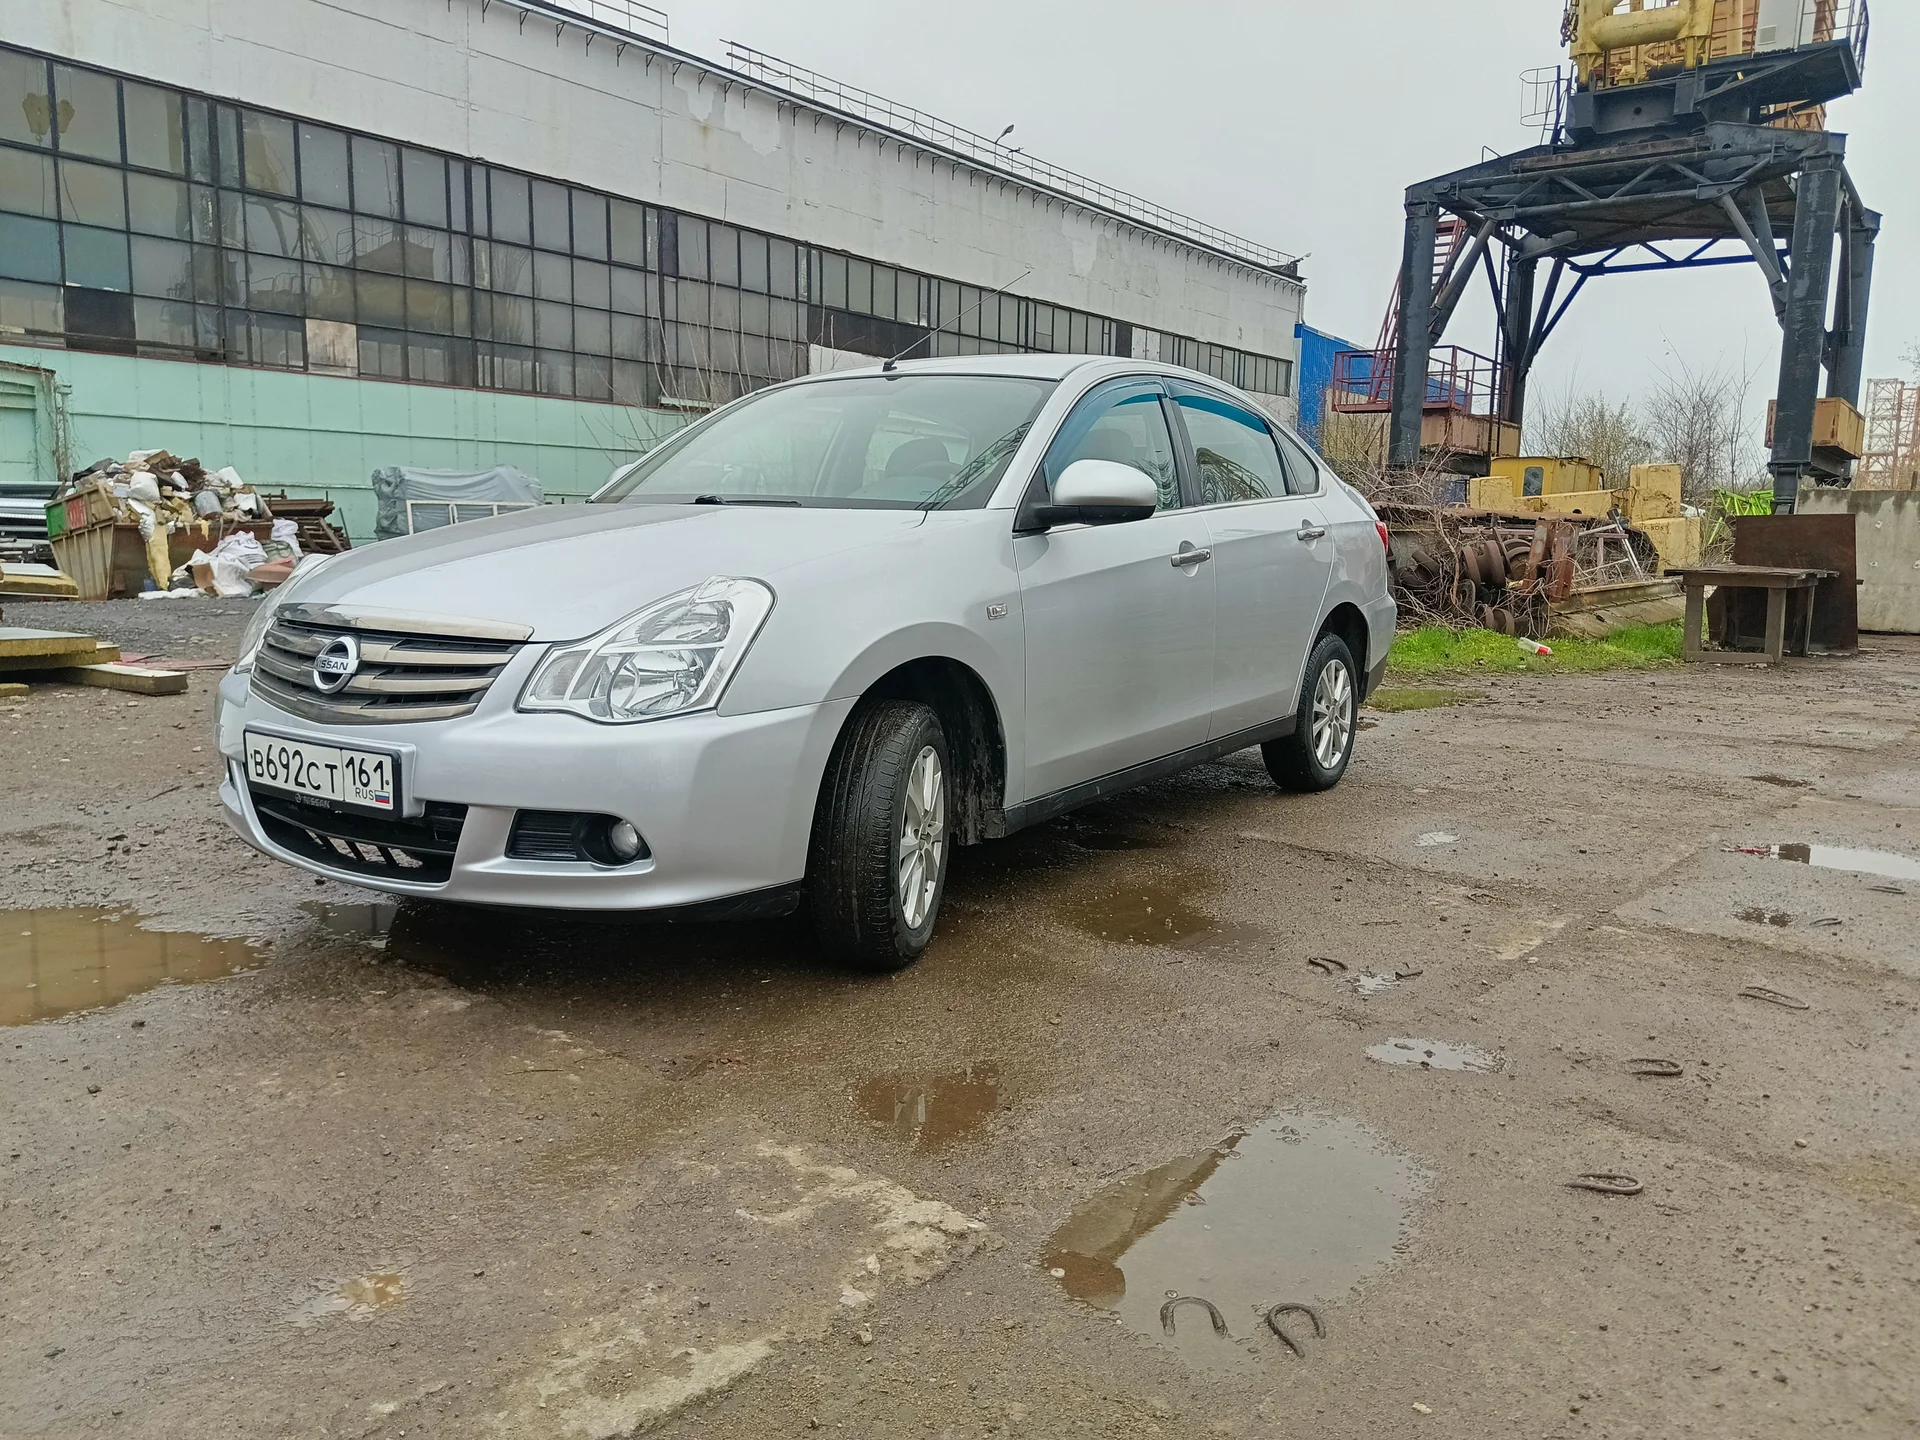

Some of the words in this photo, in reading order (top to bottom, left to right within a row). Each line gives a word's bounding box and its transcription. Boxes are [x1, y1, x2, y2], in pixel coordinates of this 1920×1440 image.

[316, 659, 349, 671] NISSAN
[345, 755, 385, 791] 161
[355, 786, 375, 801] RUS
